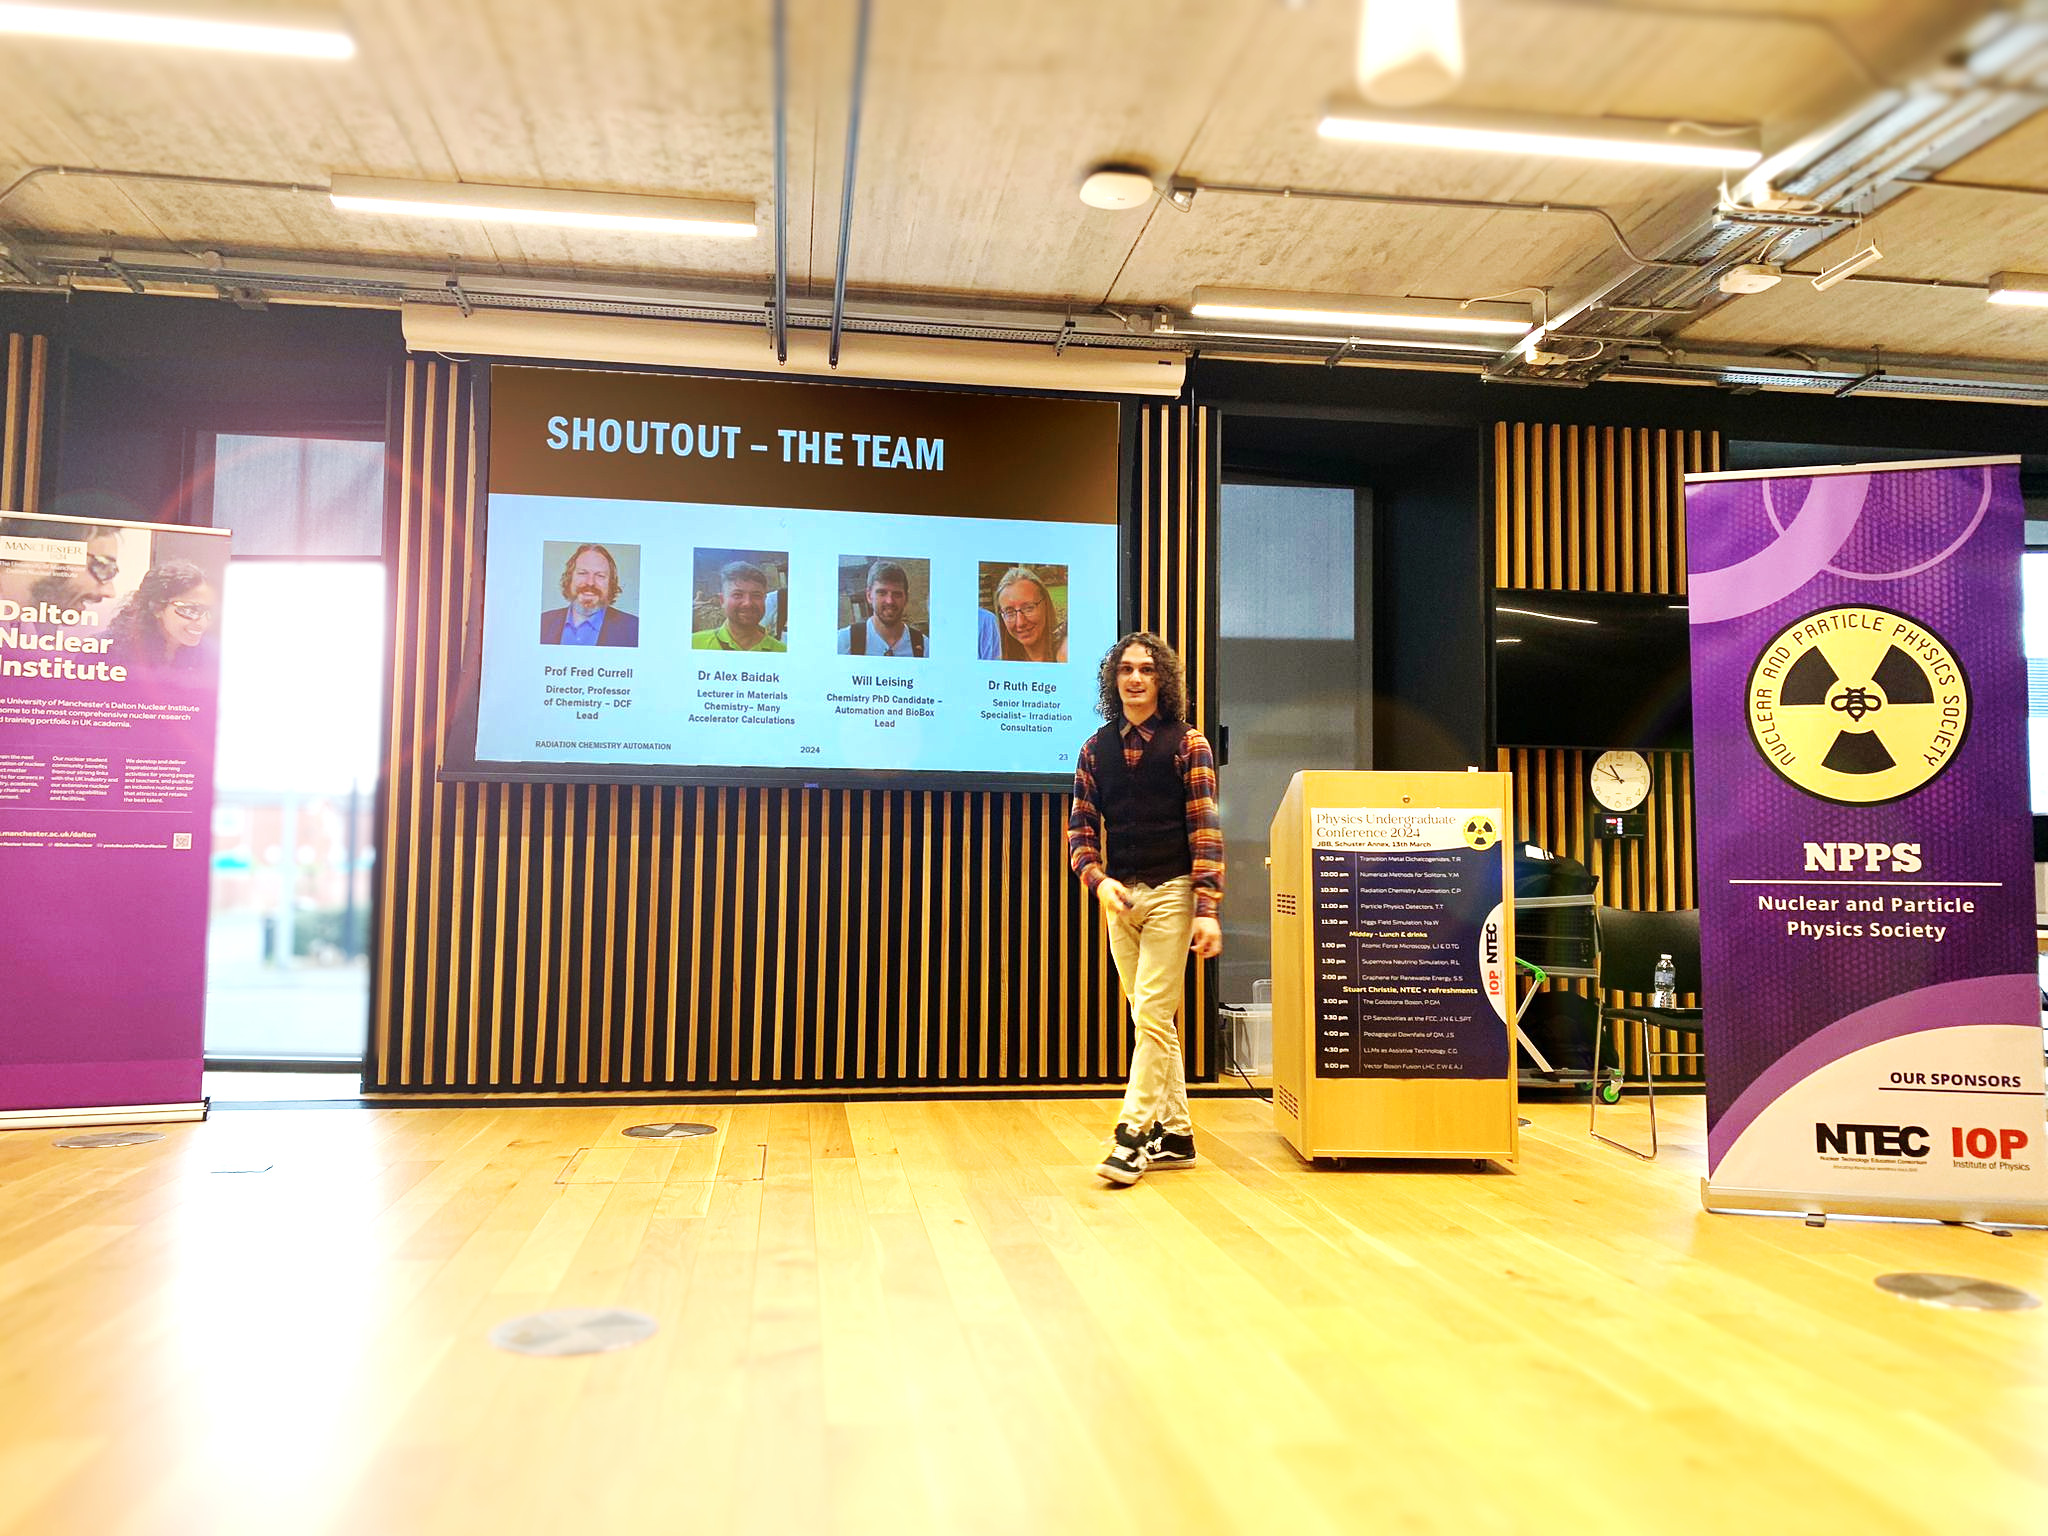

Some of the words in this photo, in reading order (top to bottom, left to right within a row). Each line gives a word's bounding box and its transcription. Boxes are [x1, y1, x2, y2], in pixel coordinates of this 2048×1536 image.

[546, 416, 741, 459] SHOUTOUT
[777, 429, 844, 465] THE
[852, 434, 944, 471] TEAM
[0, 599, 99, 626] Dalton
[1792, 613, 1885, 645] PARTICLE
[0, 627, 113, 654] Nuclear
[1892, 623, 1956, 687] PHYSICS
[1763, 646, 1791, 679] AND
[544, 666, 568, 677] Prof
[571, 667, 594, 678] Fred
[597, 667, 633, 679] Currell
[697, 671, 711, 681] Dr
[714, 671, 738, 682] Alex
[741, 672, 780, 683] Baidak
[852, 675, 872, 686] Will
[876, 676, 914, 689] Leising
[988, 680, 1001, 691] Dr
[1003, 681, 1028, 692] Ruth
[1031, 682, 1057, 694] Edge
[546, 685, 585, 695] Director,
[587, 686, 631, 696] Professor
[697, 689, 733, 699] Lecturer
[736, 690, 745, 699] in
[747, 690, 788, 700] Materials
[7, 698, 47, 707] University
[111, 702, 136, 710] Dalton
[138, 703, 167, 711] Nuclear
[168, 705, 200, 713] Institute
[544, 698, 553, 706] of
[555, 698, 602, 709] Chemistry
[613, 699, 632, 708] DCF
[826, 694, 870, 704] Chemistry
[872, 694, 890, 703] PhD
[892, 695, 935, 705] Candidate
[993, 699, 1019, 708] Senior
[1022, 700, 1061, 709] Irradiator
[69, 710, 128, 719] comprehensive
[757, 703, 781, 714] Many
[835, 706, 885, 716] Automation
[887, 707, 903, 716] and
[905, 708, 935, 717] BioBox
[5, 717, 35, 725] training
[576, 711, 599, 720] Lead
[688, 714, 739, 724] Accelerator
[741, 715, 795, 725] Calculations
[1029, 712, 1073, 722] Irradiation
[874, 719, 895, 728] Lead
[1000, 723, 1053, 733] Consultation
[1756, 688, 1796, 767] NUCLEAR
[1923, 695, 1960, 767] SOCIETY
[535, 740, 577, 749] RADIATION
[578, 741, 621, 750] CHEMISTRY
[623, 742, 672, 750] AUTOMATION
[800, 746, 820, 754] 2024
[1317, 813, 1363, 826] Physics
[1366, 813, 1456, 828] Undergraduate
[1317, 827, 1387, 838] Conference
[1390, 827, 1420, 838] 2024
[1803, 842, 1923, 873] NPPS
[1758, 896, 1839, 912] Nuclear
[1846, 897, 1884, 912] and
[1891, 897, 1975, 913] Particle
[1787, 921, 1864, 938] Physics
[1869, 922, 1947, 942] Society
[1486, 923, 1497, 963] NTEC
[1489, 970, 1500, 995] IOP
[1890, 1072, 1926, 1085] OUR
[1931, 1073, 2021, 1088] SPONSORS
[1815, 1122, 1931, 1158] NTEC
[1952, 1126, 2029, 1160] IOP
[1953, 1160, 1987, 1170] Institute
[1989, 1161, 1997, 1170] of
[1999, 1162, 2030, 1172] Physics
